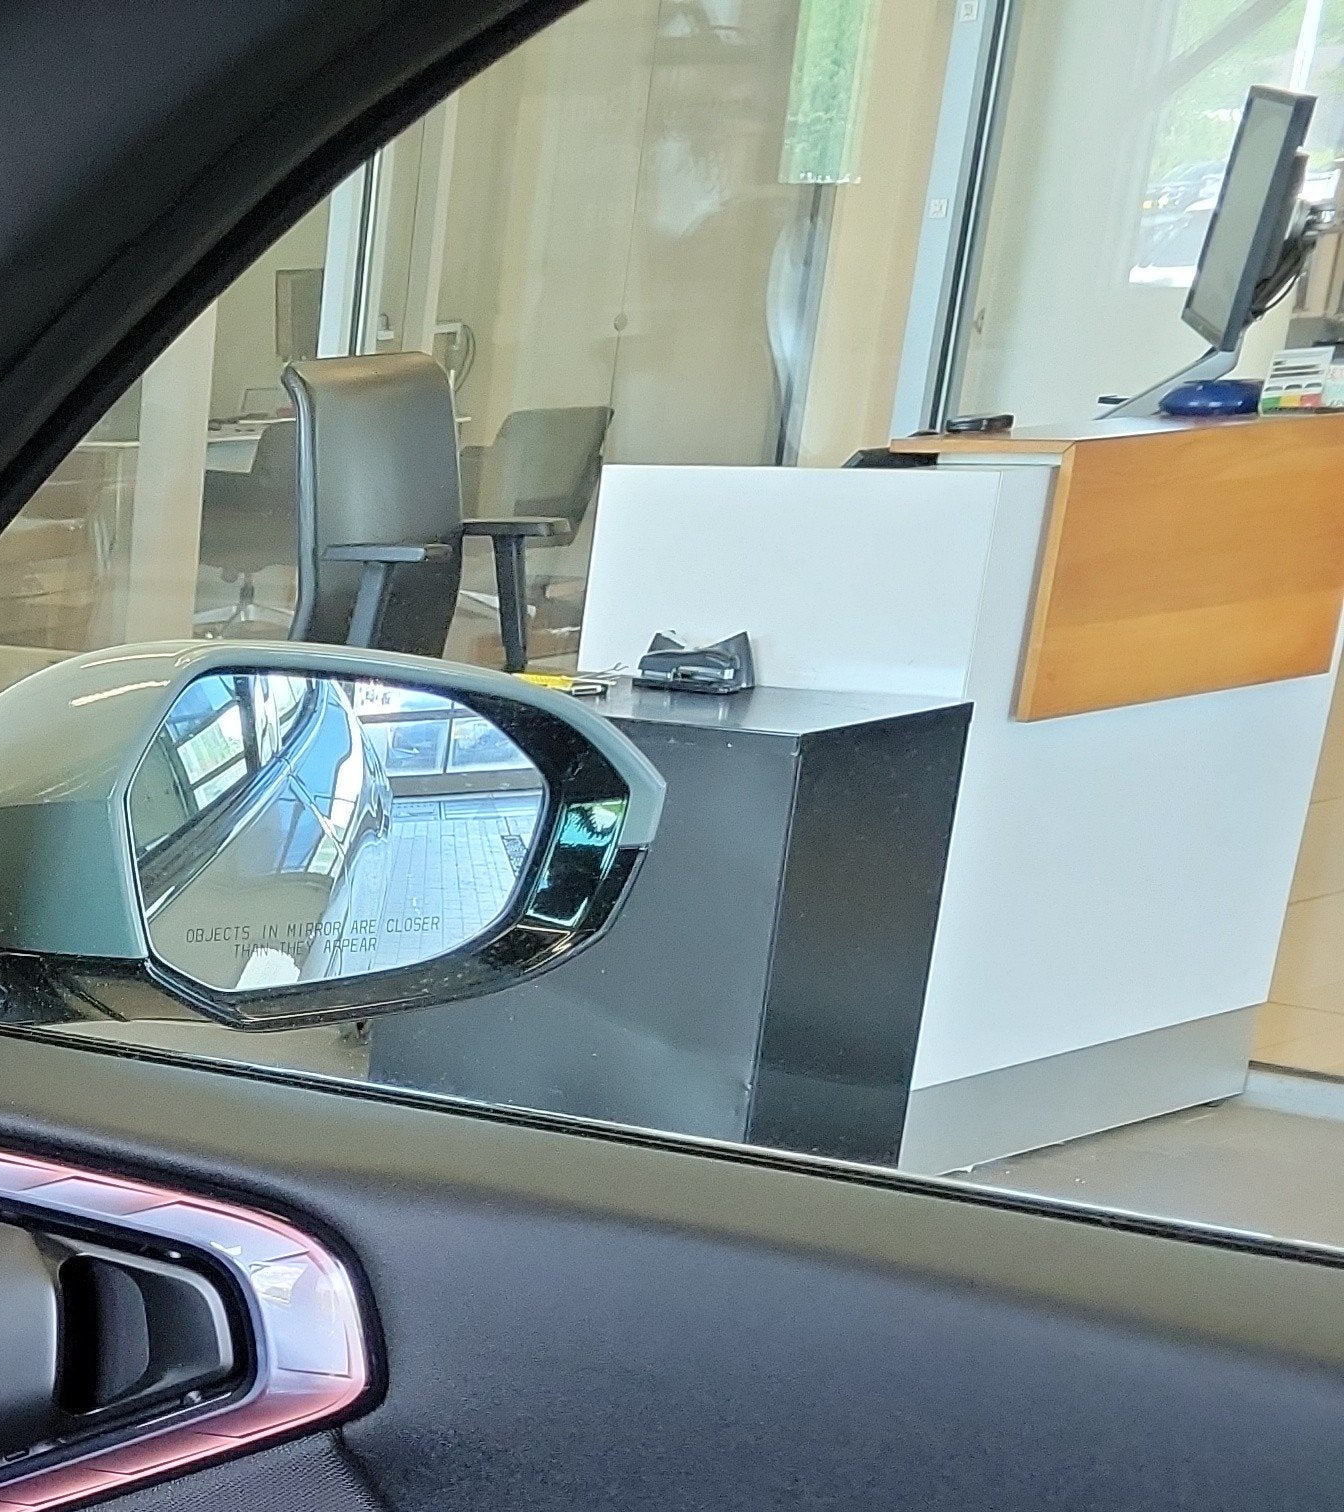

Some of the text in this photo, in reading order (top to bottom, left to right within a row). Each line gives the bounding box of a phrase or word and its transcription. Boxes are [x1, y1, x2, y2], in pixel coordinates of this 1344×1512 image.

[186, 916, 440, 944] OBJECTS IN MIRROR ARE CLOSER
[234, 937, 378, 959] THAN THEY APPEAR
